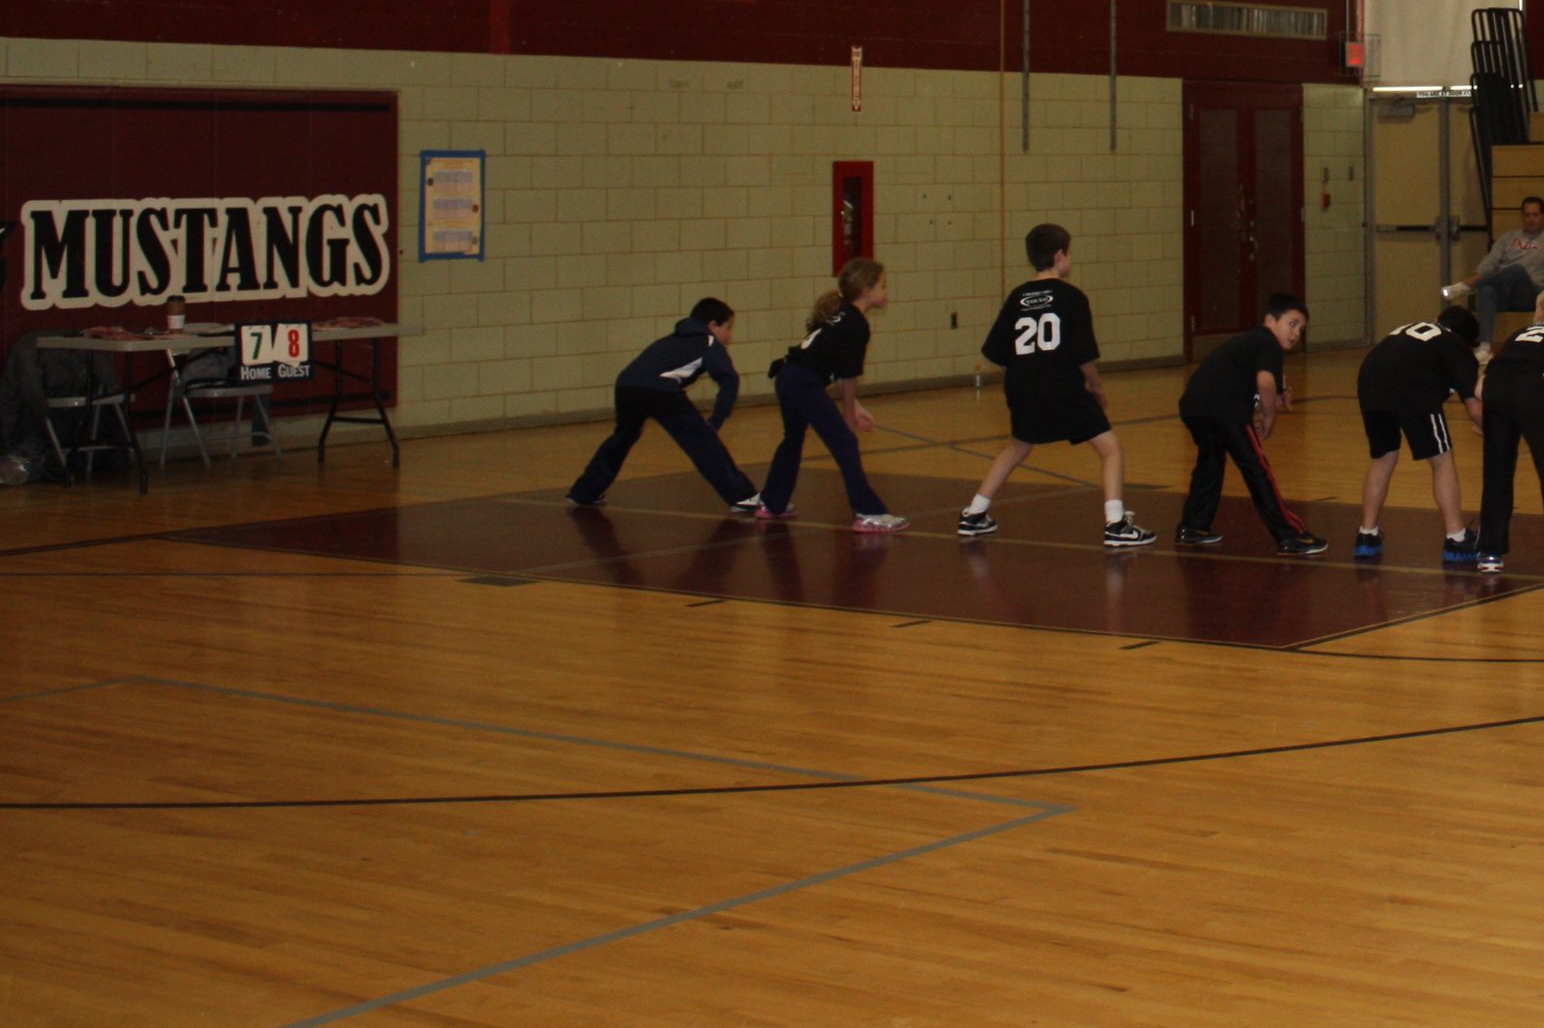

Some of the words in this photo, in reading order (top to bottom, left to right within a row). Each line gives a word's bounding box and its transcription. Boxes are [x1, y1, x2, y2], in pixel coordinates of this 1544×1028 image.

[30, 202, 384, 300] MUSTANGS
[250, 332, 263, 360] 7
[288, 329, 300, 357] 8
[1014, 312, 1061, 355] 20
[240, 366, 272, 381] HOME
[277, 363, 311, 378] GUEST
